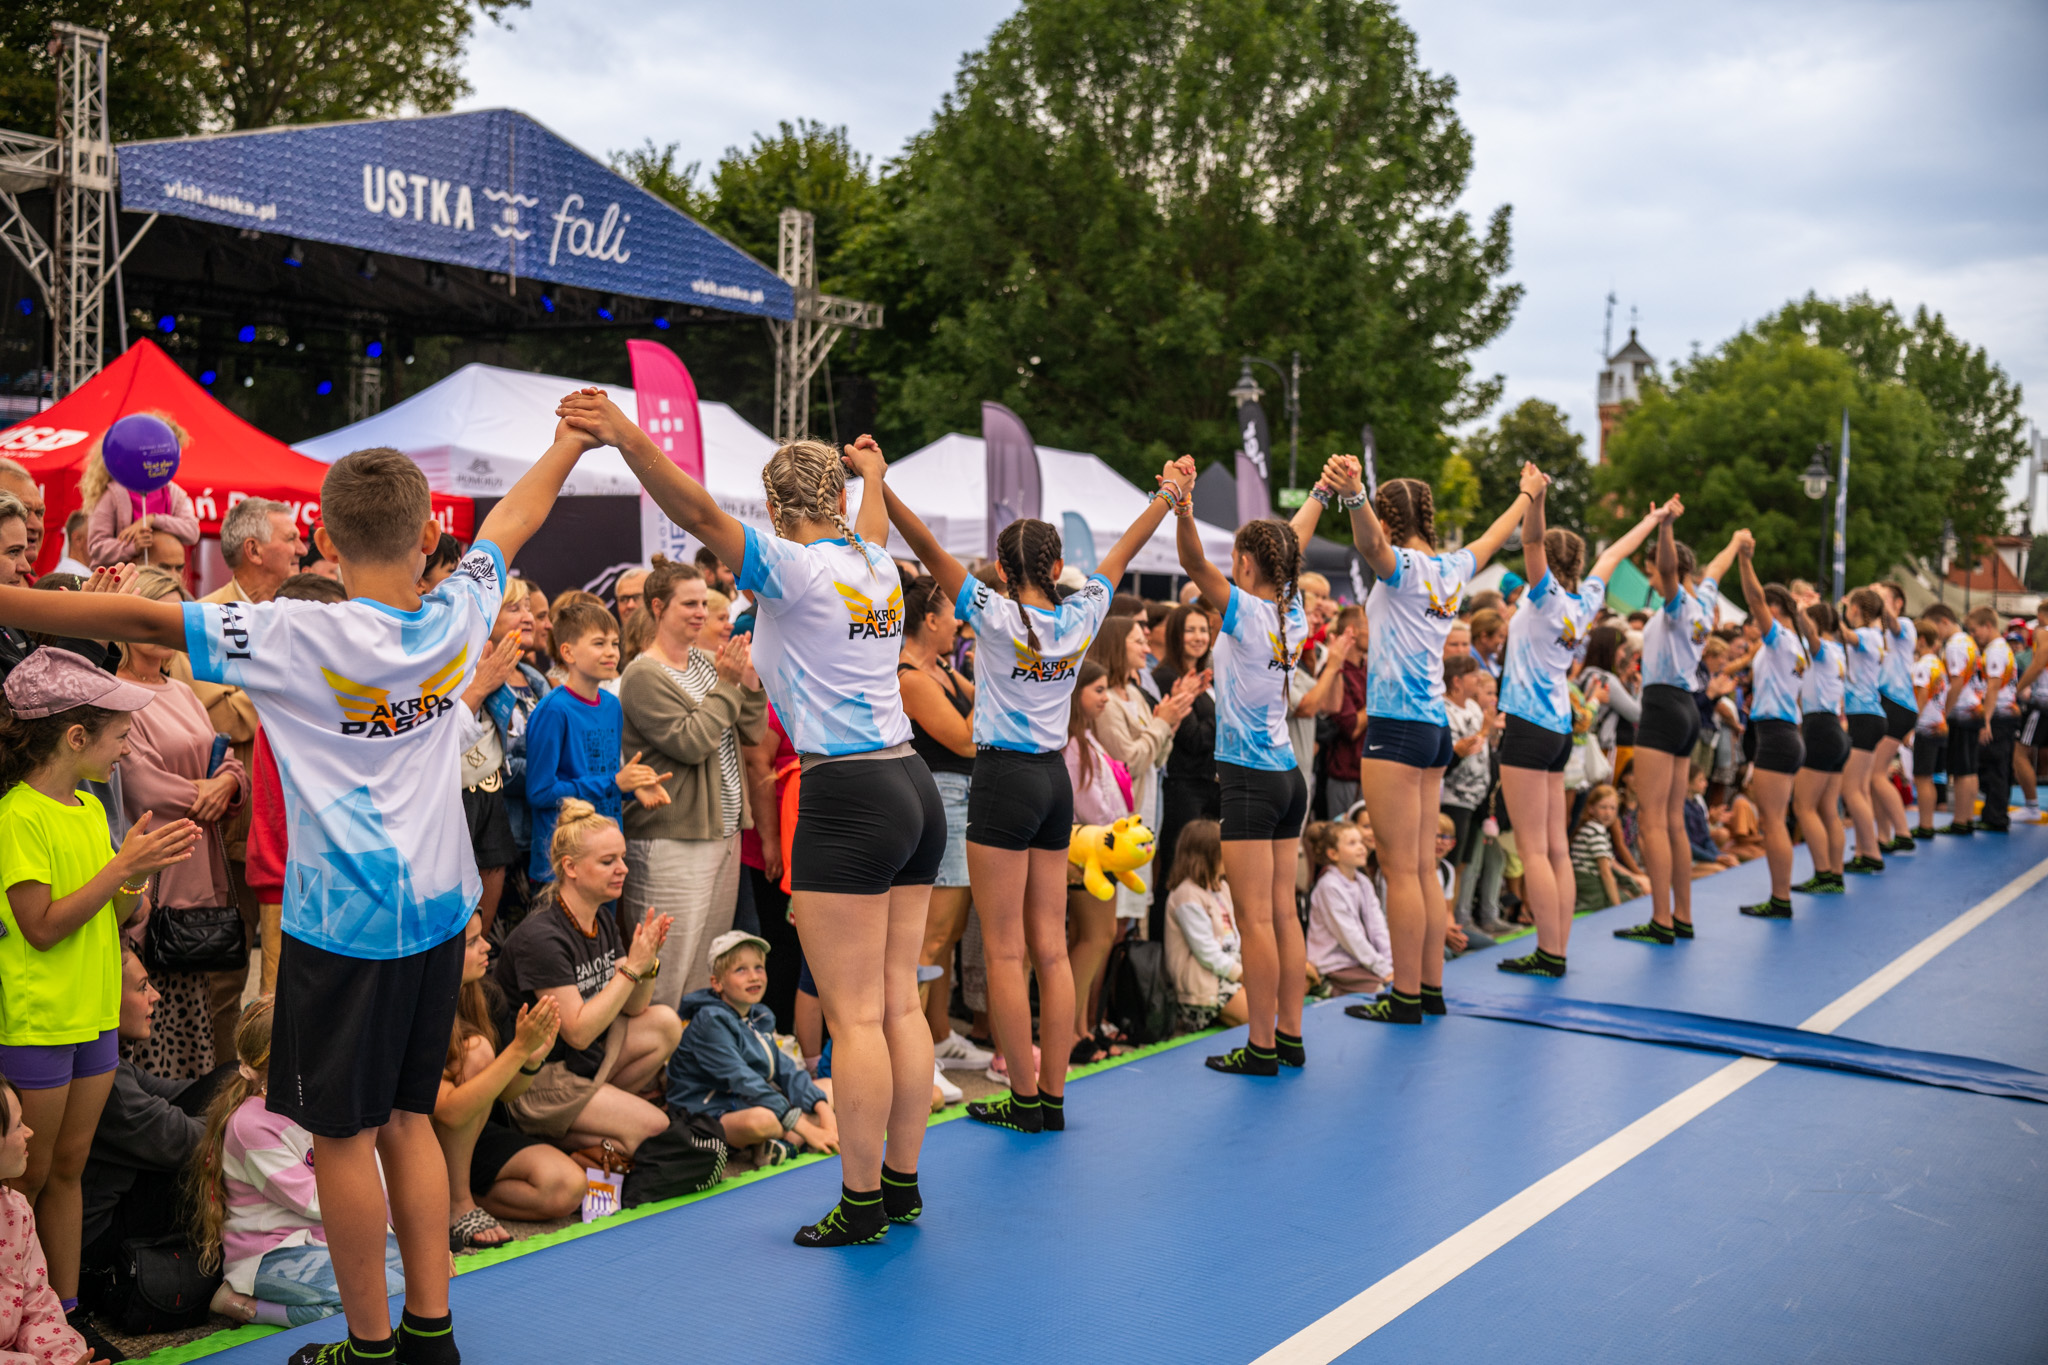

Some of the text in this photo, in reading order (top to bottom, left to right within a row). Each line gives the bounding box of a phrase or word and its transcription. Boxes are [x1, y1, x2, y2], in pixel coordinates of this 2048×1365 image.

[163, 180, 277, 222] visit.ustka.pl
[362, 164, 475, 231] USTKA
[549, 193, 631, 267] fali
[865, 608, 897, 622] AKRO
[848, 620, 902, 640] PASJA
[1010, 666, 1075, 682] PASJA
[1030, 660, 1068, 671] AKRO
[370, 694, 440, 720] AKRO
